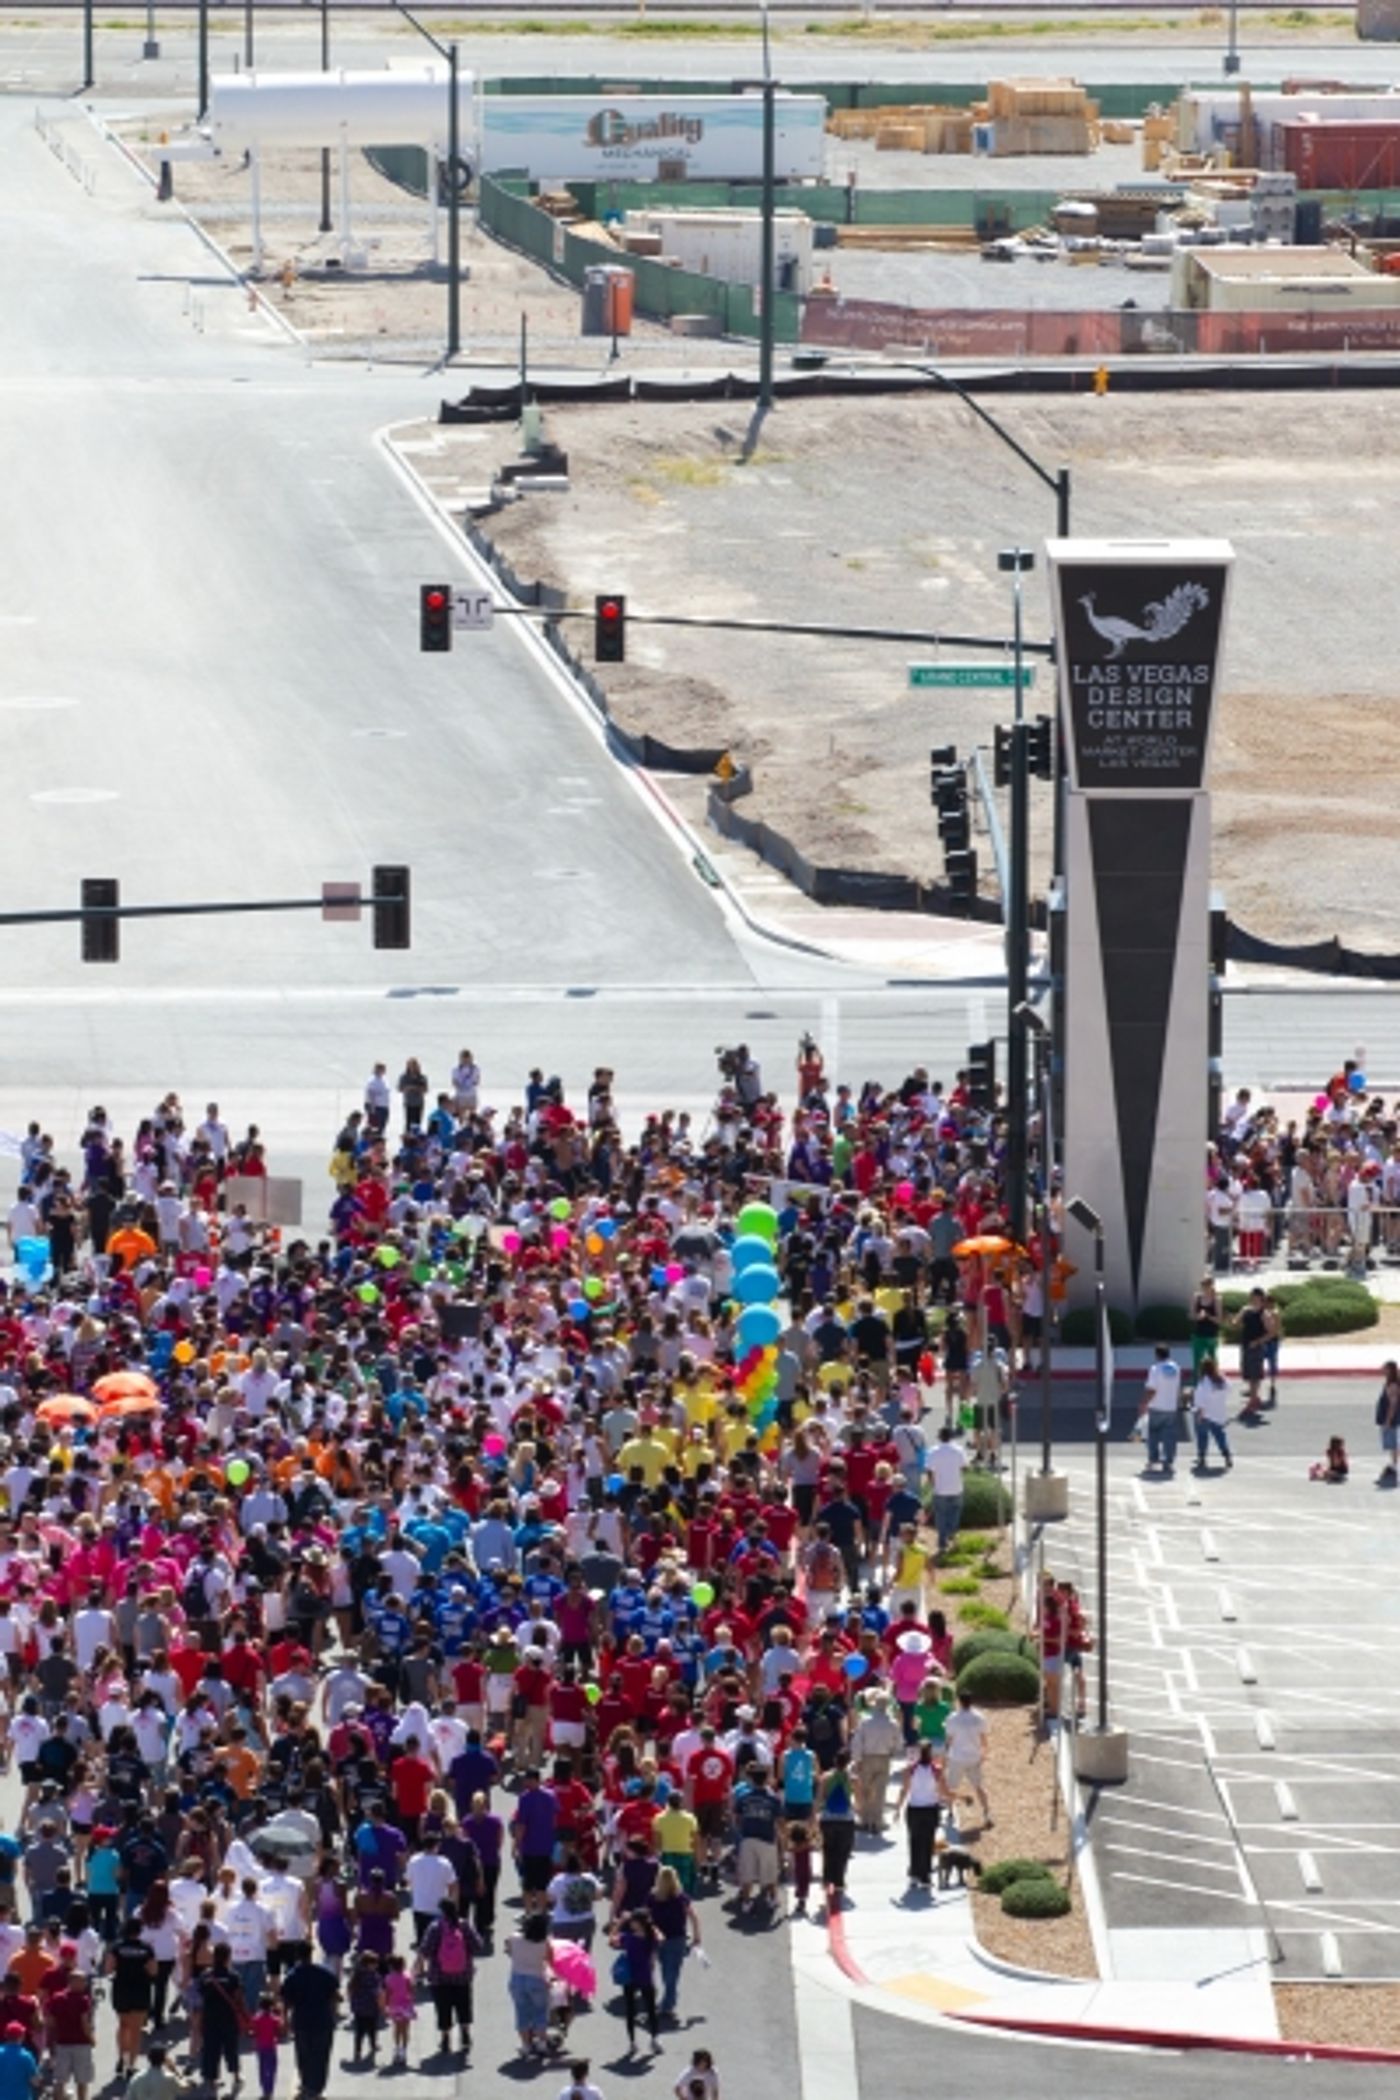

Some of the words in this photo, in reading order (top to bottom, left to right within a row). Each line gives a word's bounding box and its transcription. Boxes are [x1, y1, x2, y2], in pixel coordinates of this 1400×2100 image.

[583, 108, 703, 147] Quality
[1073, 664, 1120, 684] LAS
[1126, 664, 1209, 684] VEGAS
[1088, 686, 1192, 705] DESIGN
[1088, 709, 1192, 729] CENTER
